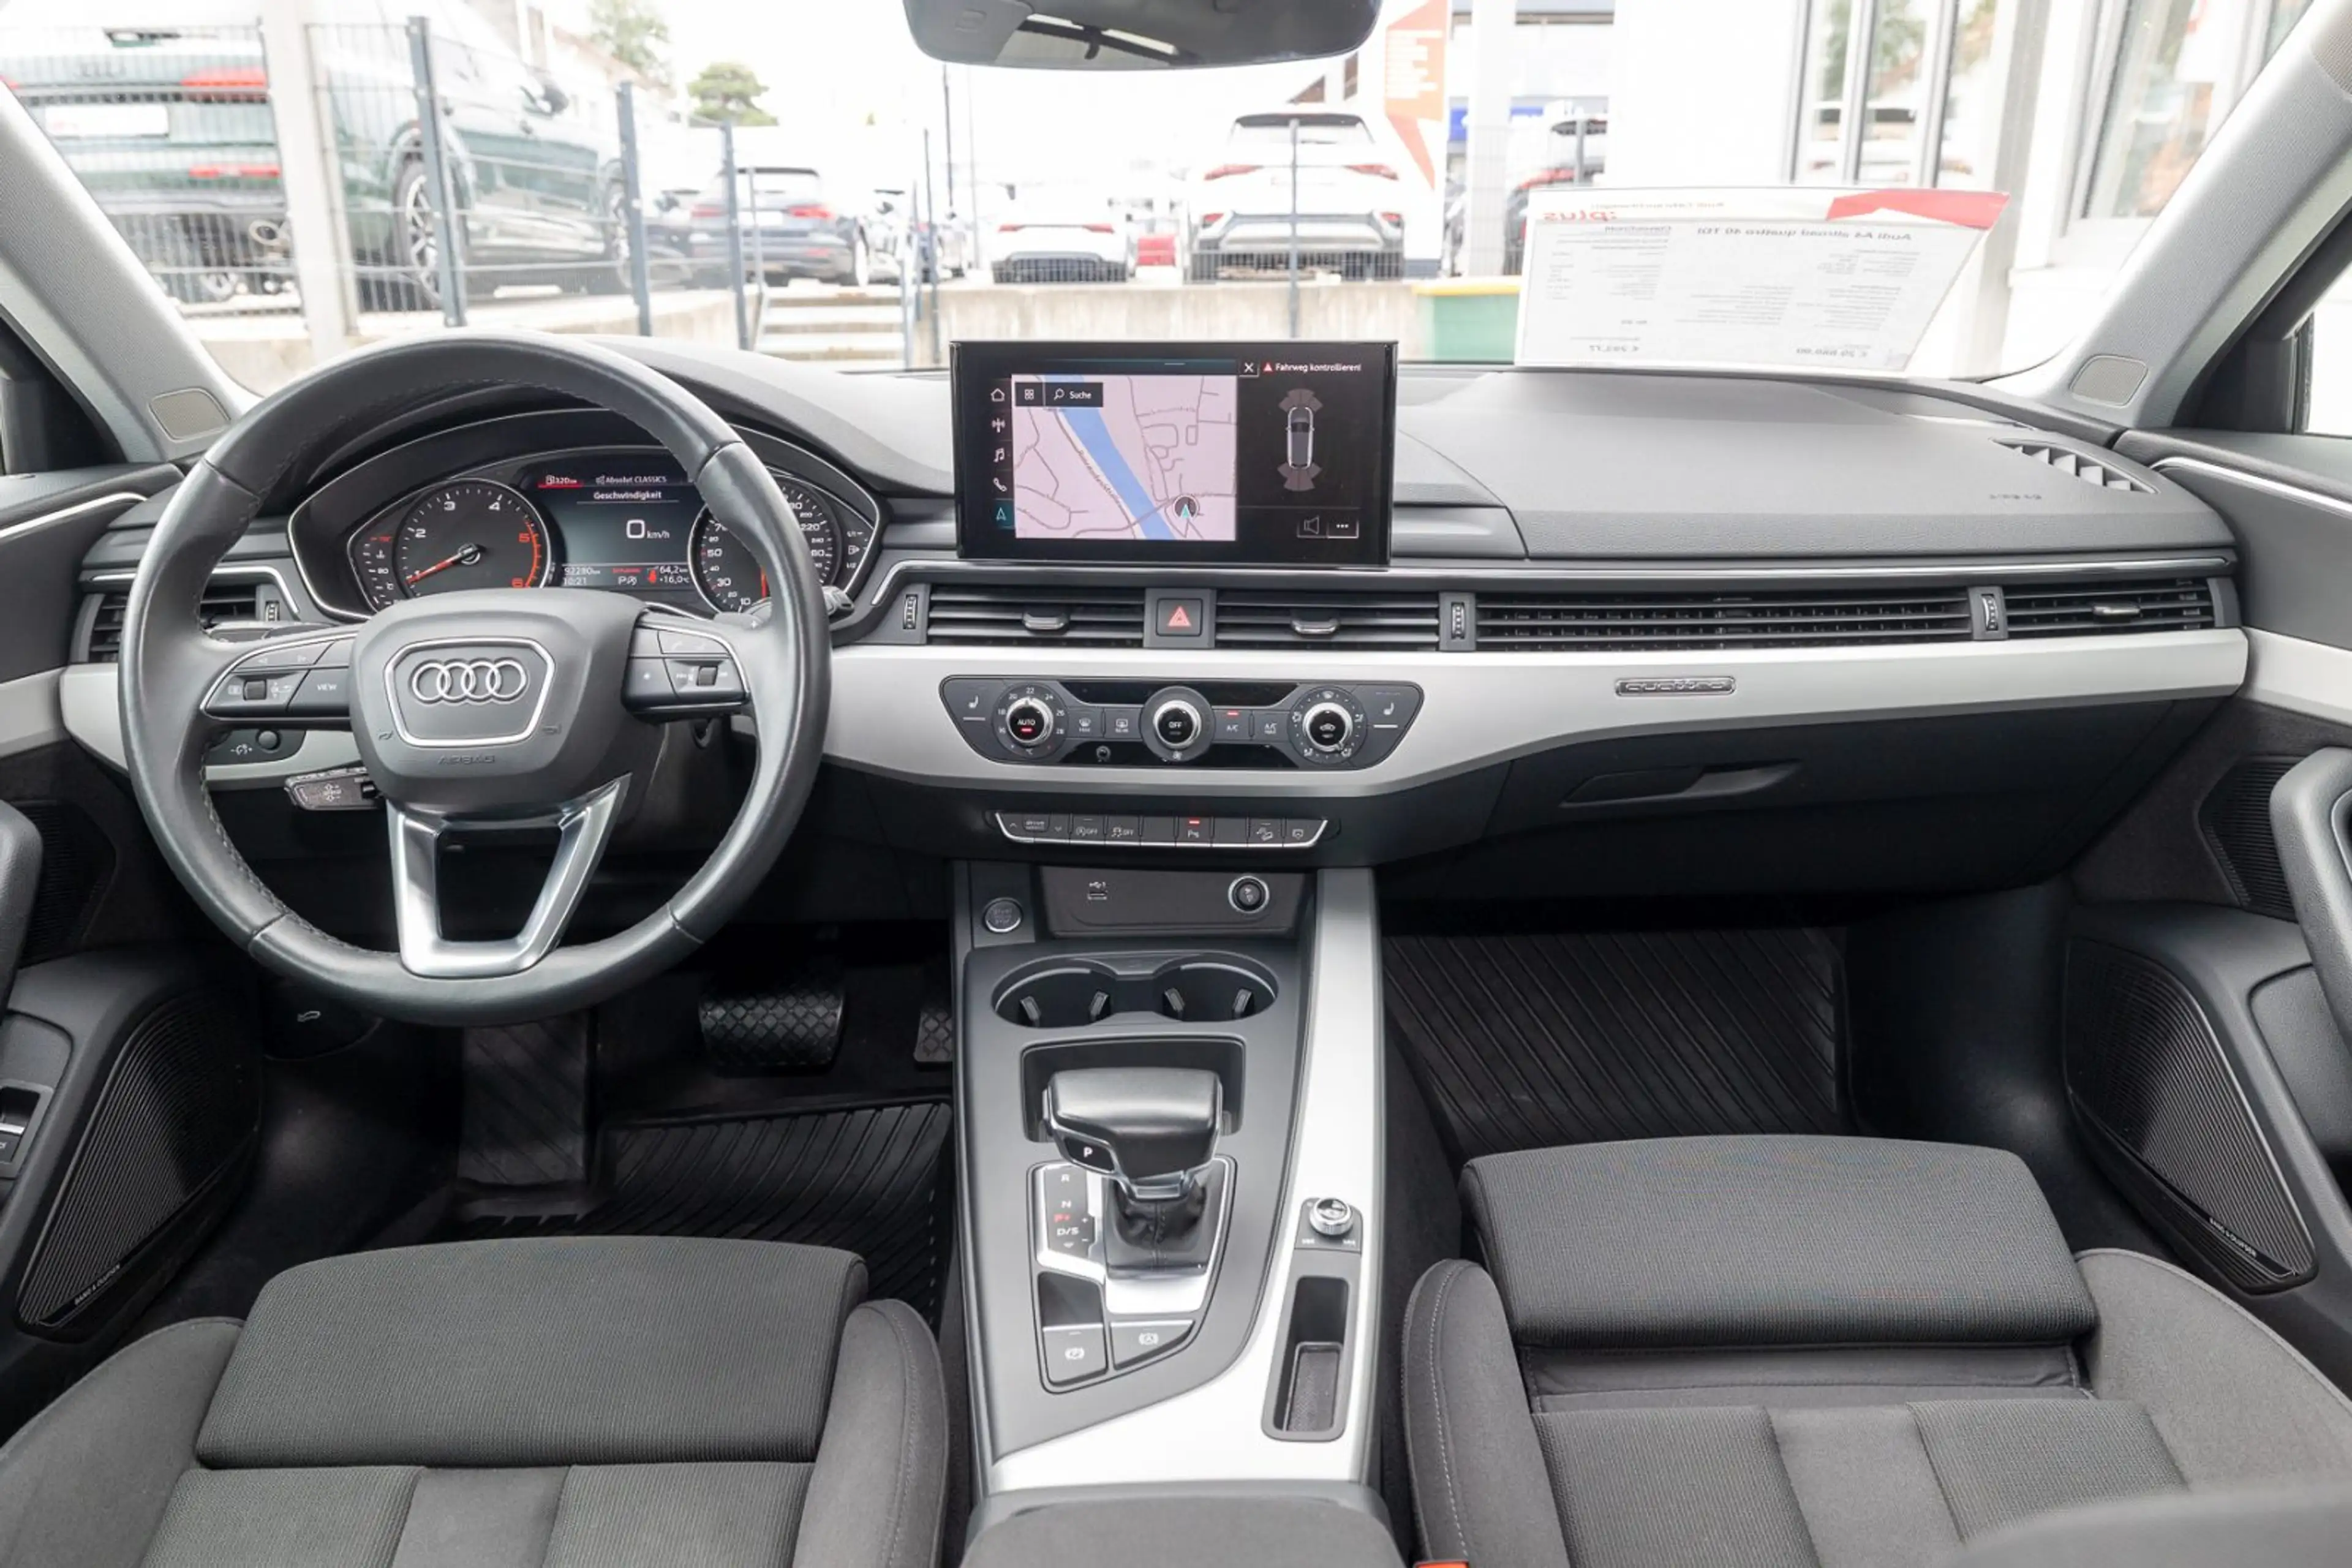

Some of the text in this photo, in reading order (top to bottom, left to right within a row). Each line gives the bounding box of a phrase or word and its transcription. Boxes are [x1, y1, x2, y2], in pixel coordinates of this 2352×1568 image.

[1275, 363, 1308, 373] Fahrweg
[1069, 391, 1092, 399] Suche
[593, 491, 662, 500] Geschwindigkeit
[444, 501, 456, 510] 3
[488, 502, 500, 510] 4
[415, 529, 426, 538] 2
[626, 519, 670, 539] 0 km/h
[519, 533, 530, 541] 5
[707, 548, 723, 557] 50
[717, 578, 731, 586] 30
[1083, 1147, 1093, 1158] P
[1060, 1200, 1072, 1209] N
[1057, 1227, 1079, 1236] D/S
